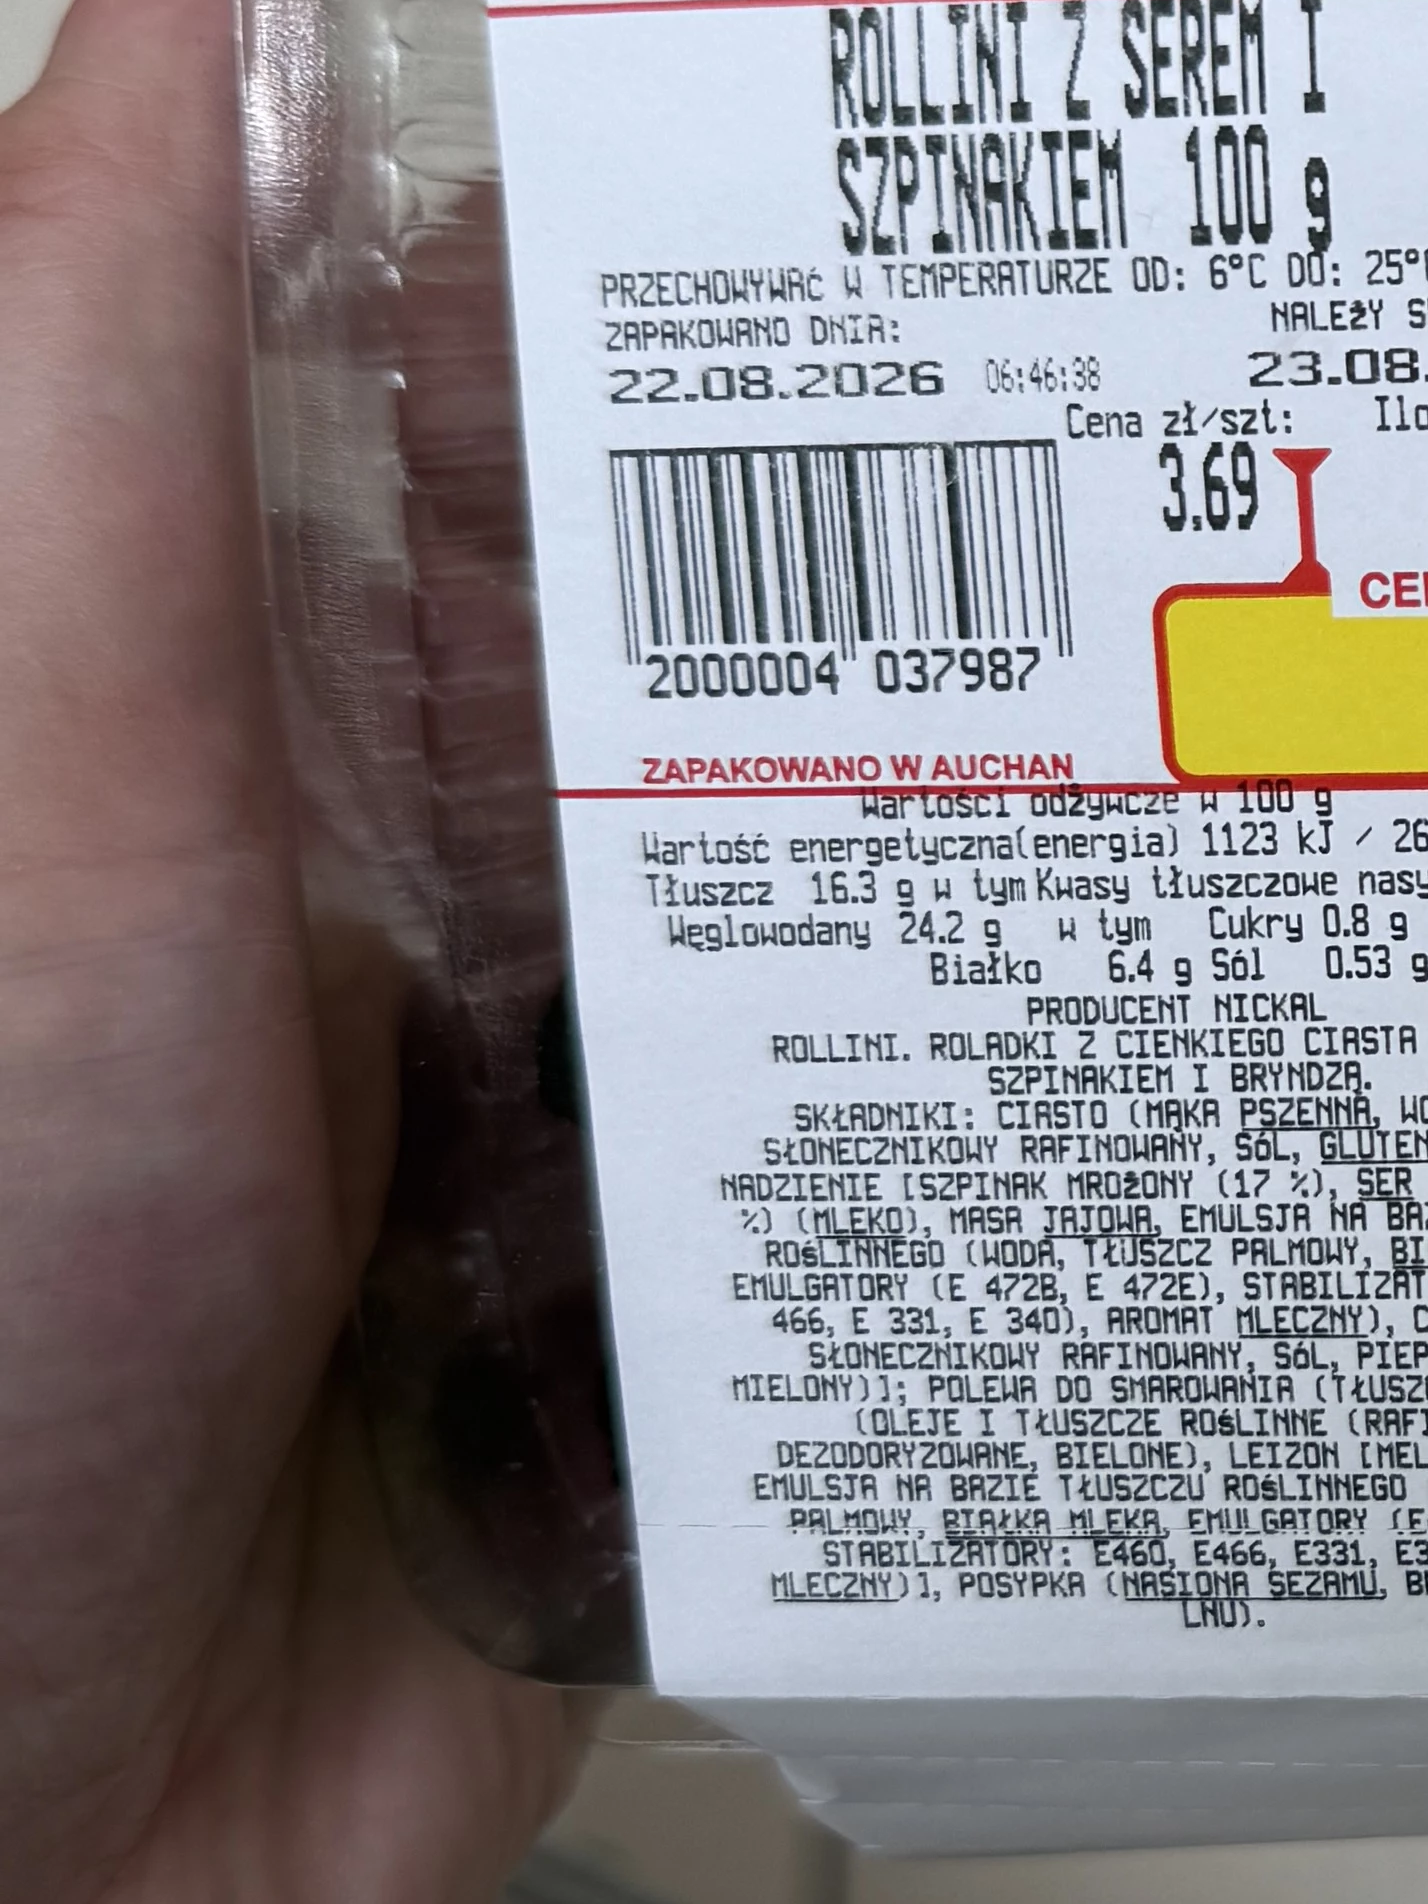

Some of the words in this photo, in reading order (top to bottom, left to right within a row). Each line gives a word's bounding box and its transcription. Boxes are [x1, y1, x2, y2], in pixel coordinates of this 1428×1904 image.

[829, 0, 1032, 129] ROLLINI
[837, 129, 1127, 256] SZPINAKIEM
[1186, 124, 1273, 246] 100
[1304, 157, 1332, 252] g
[844, 266, 862, 298] W
[882, 257, 1112, 298] TEMPERATURZE
[1132, 256, 1184, 292] OD:
[1209, 253, 1266, 290] 6°C
[1288, 247, 1340, 287] DO:
[605, 317, 790, 351] ZAPAKOWANO
[810, 314, 899, 345] DNIA:
[609, 361, 944, 404] 22.08.2026
[986, 356, 1100, 393] 06:46:38
[1066, 403, 1142, 439] Cena
[1163, 398, 1291, 437] zł/szt:
[1159, 441, 1258, 532] 3.69
[646, 651, 841, 700] 2000004
[874, 646, 1042, 694] 037987
[643, 756, 880, 784] ZAPAKOWANO
[890, 756, 921, 780] W
[932, 754, 1072, 780] AUCHAN
[862, 788, 1011, 821] Wartości
[1030, 784, 1180, 821] odżywcze
[1201, 792, 1219, 814] w
[1239, 780, 1295, 815] 100
[1315, 788, 1334, 817] g
[642, 832, 770, 865] Wartość
[1203, 821, 1278, 856] 1123
[1297, 820, 1333, 855] kJ
[645, 874, 774, 907] Tłuszcz
[812, 870, 876, 905] 16.3
[897, 879, 914, 907] g
[934, 878, 951, 902] w
[973, 868, 1026, 906] tym
[1036, 867, 1130, 904] Kwasy
[1152, 865, 1338, 899] tłuszczowe
[668, 913, 871, 950] Węglowodany
[899, 910, 964, 944] 24.2
[984, 919, 1001, 946] g
[1059, 917, 1076, 941] w
[1098, 908, 1151, 944] tym
[1209, 905, 1303, 942] Cukry
[1323, 903, 1369, 937] 0.8
[1390, 912, 1408, 940] g
[930, 952, 1041, 985] Białko
[1108, 950, 1154, 983] 6.4
[1174, 957, 1192, 987] g
[1212, 947, 1265, 981] Sól
[1325, 945, 1391, 979] 0.53
[1411, 953, 1428, 982] g
[1027, 994, 1190, 1026] PRODUCENT
[1214, 992, 1327, 1023] NICKAL
[772, 1033, 910, 1063] ROLLINI.
[930, 1031, 1057, 1061] ROLADKI
[1078, 1030, 1096, 1059] Z
[1116, 1027, 1284, 1059] CIENKIEGO
[1304, 1025, 1417, 1056] CIASTA
[988, 1064, 1173, 1095] SZPINAKIEM
[1193, 1063, 1209, 1093] I
[794, 1102, 973, 1132] SKŁADNIKI:
[997, 1100, 1107, 1130] CIASTO
[1240, 1094, 1380, 1129] PSZENNA,
[764, 1135, 997, 1166] SŁONECZNIKOWY
[1020, 1130, 1215, 1165] RAFINOWANY,
[721, 1173, 882, 1202] NADZIENIE
[903, 1171, 1048, 1201] [SZPINAK
[1218, 1169, 1270, 1198] (17
[1357, 1167, 1412, 1199] SER
[928, 1375, 1037, 1403] POLEWA
[1055, 1375, 1092, 1403] DO
[1111, 1372, 1294, 1404] SMAROWANIA
[777, 1441, 1037, 1473] DEZODORYZOWANE,
[1056, 1441, 1211, 1473] BIELONE),
[823, 1538, 1071, 1572] STABILIZATORY:
[1093, 1538, 1176, 1572] E460,
[1194, 1540, 1276, 1572] E466,
[1294, 1539, 1377, 1571] E331,
[958, 1571, 1085, 1598] POSYPKA
[1106, 1569, 1250, 1601] (NASIONA
[1268, 1569, 1387, 1601] SEZAMU,
[1182, 1600, 1265, 1628] LNU).
